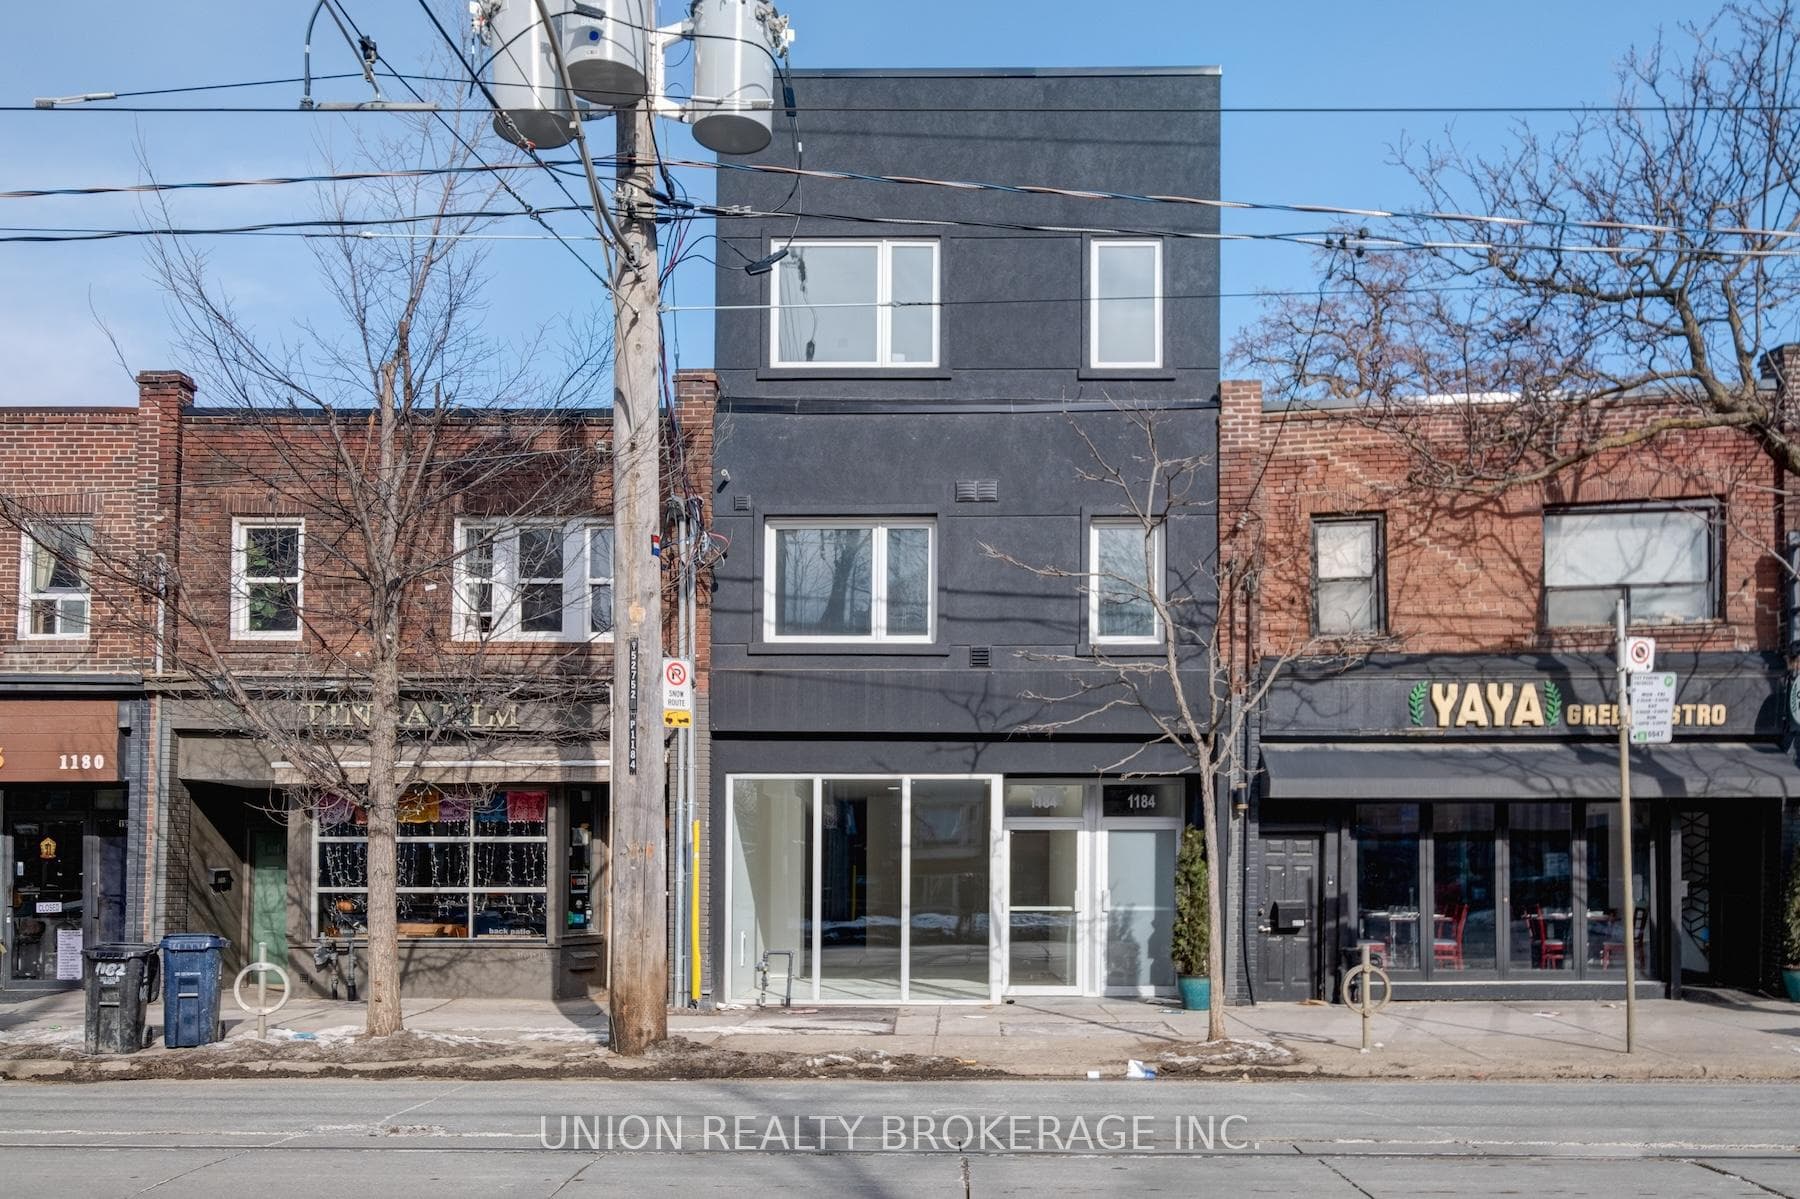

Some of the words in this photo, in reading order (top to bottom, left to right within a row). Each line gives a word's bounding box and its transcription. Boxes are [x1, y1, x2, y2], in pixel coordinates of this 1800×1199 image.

[667, 699, 686, 707] ROUTE
[1431, 681, 1545, 727] YAYA
[1567, 704, 1632, 726] GREE
[1670, 704, 1727, 726] STRO
[59, 754, 105, 770] 1180
[1128, 794, 1156, 809] 1184
[38, 904, 60, 912] CLOSED
[488, 927, 508, 935] back
[510, 927, 531, 936] patio
